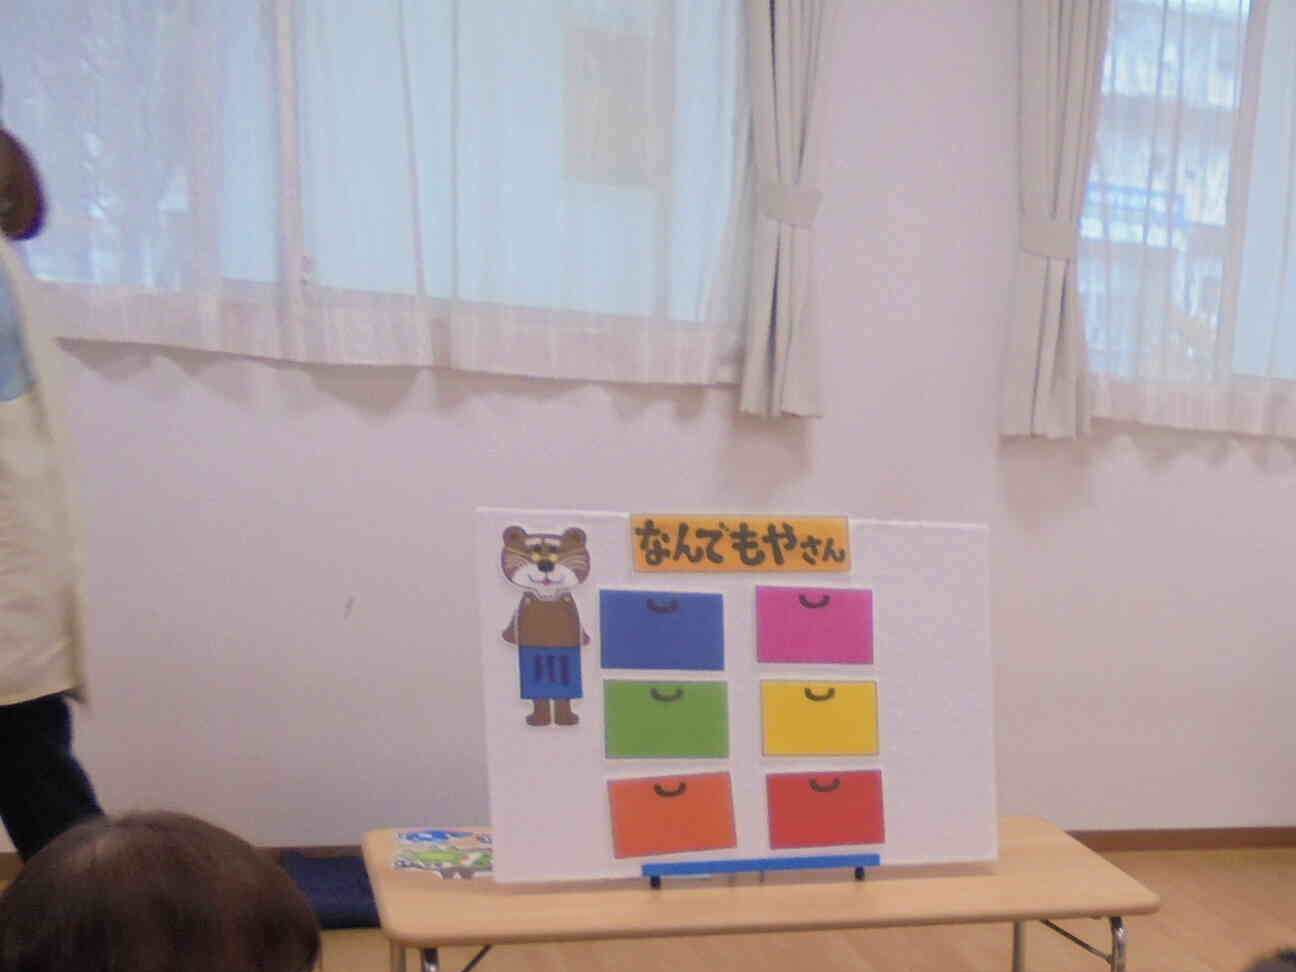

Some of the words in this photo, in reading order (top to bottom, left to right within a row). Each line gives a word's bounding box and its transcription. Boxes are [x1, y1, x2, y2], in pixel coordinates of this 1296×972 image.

[635, 519, 845, 566] なんでもやさん
